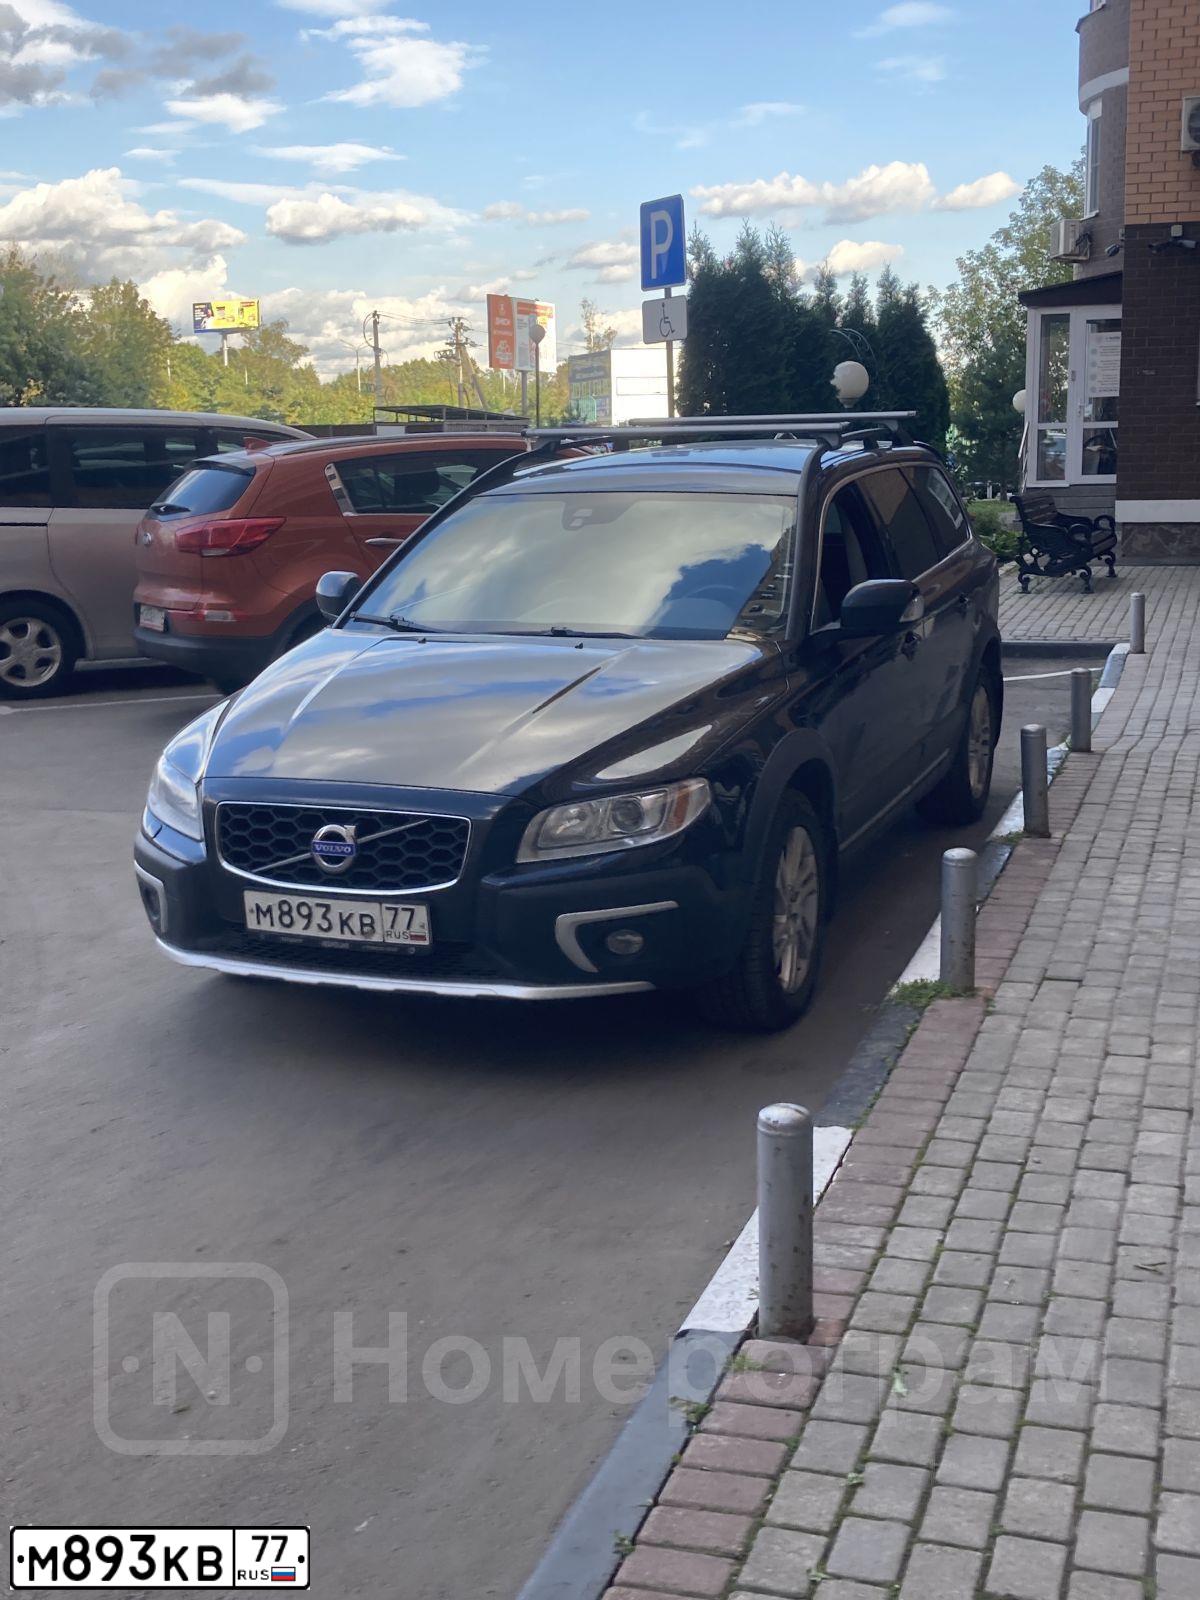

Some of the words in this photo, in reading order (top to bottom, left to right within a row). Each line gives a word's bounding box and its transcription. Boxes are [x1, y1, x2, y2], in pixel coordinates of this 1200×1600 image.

[649, 209, 674, 280] P
[314, 844, 352, 854] VOLVO
[384, 905, 416, 931] 77
[385, 930, 410, 941] RUS
